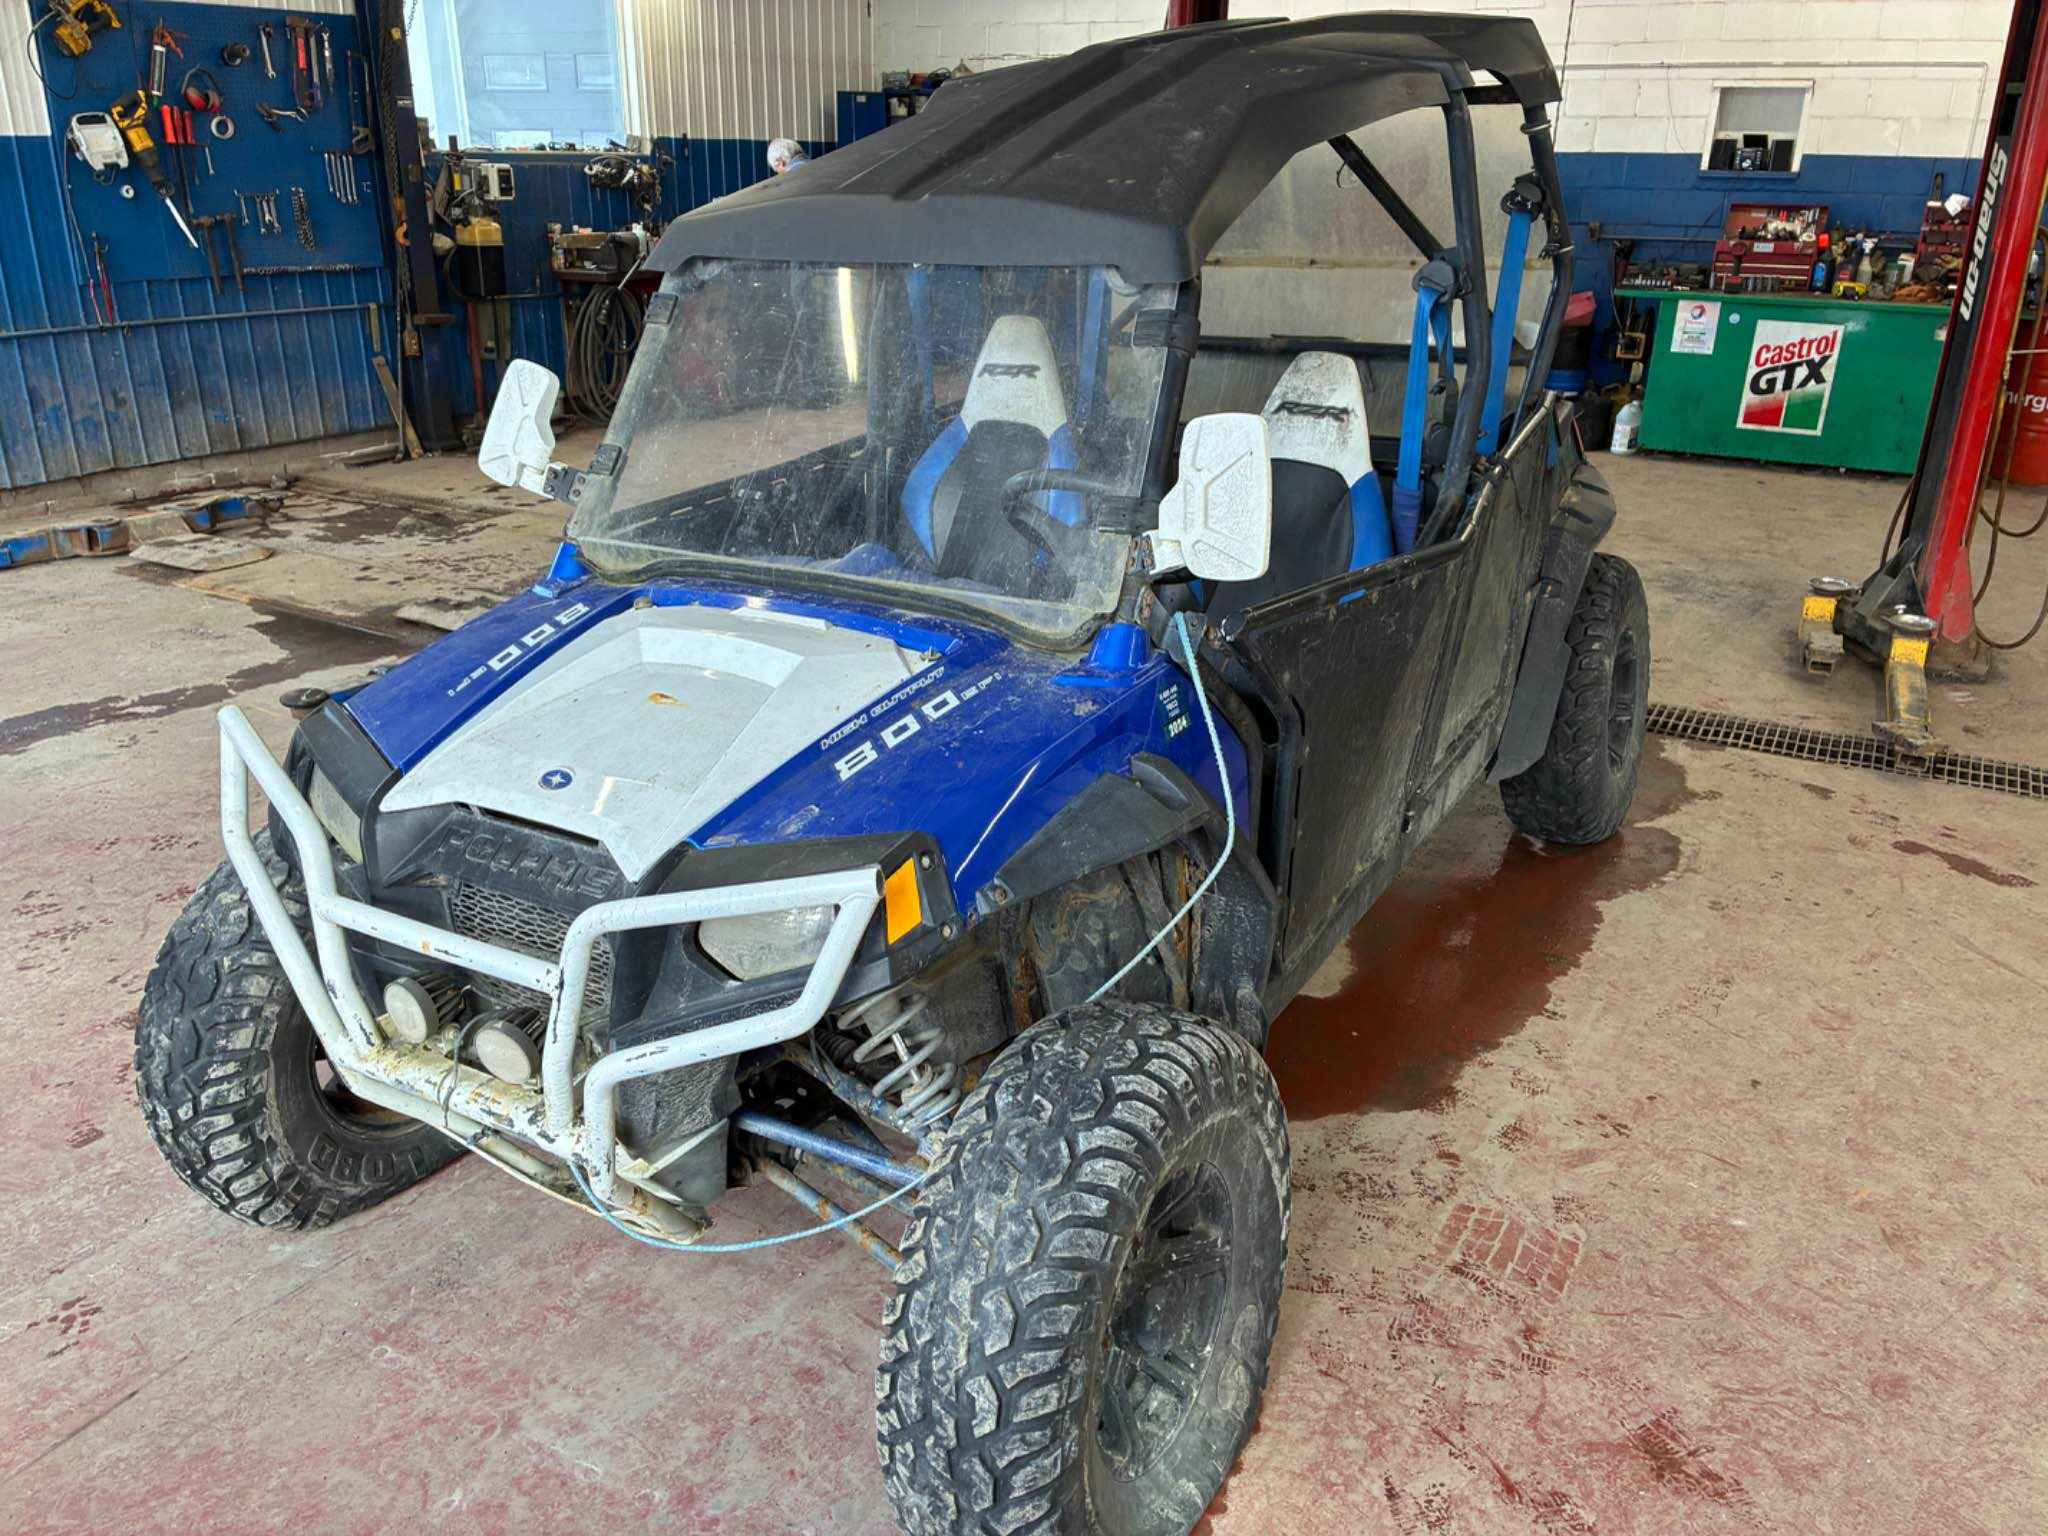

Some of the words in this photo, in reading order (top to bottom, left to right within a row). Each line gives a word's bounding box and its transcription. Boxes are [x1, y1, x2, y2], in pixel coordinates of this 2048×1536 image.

[1959, 142, 2007, 321] Snap-on
[977, 363, 1041, 380] RZR
[1750, 354, 1833, 396] GTX
[1755, 329, 1839, 368] Castrol
[1271, 401, 1350, 423] RZR
[487, 602, 591, 672] 800
[834, 689, 961, 782] 800
[432, 833, 620, 900] POLARIS
